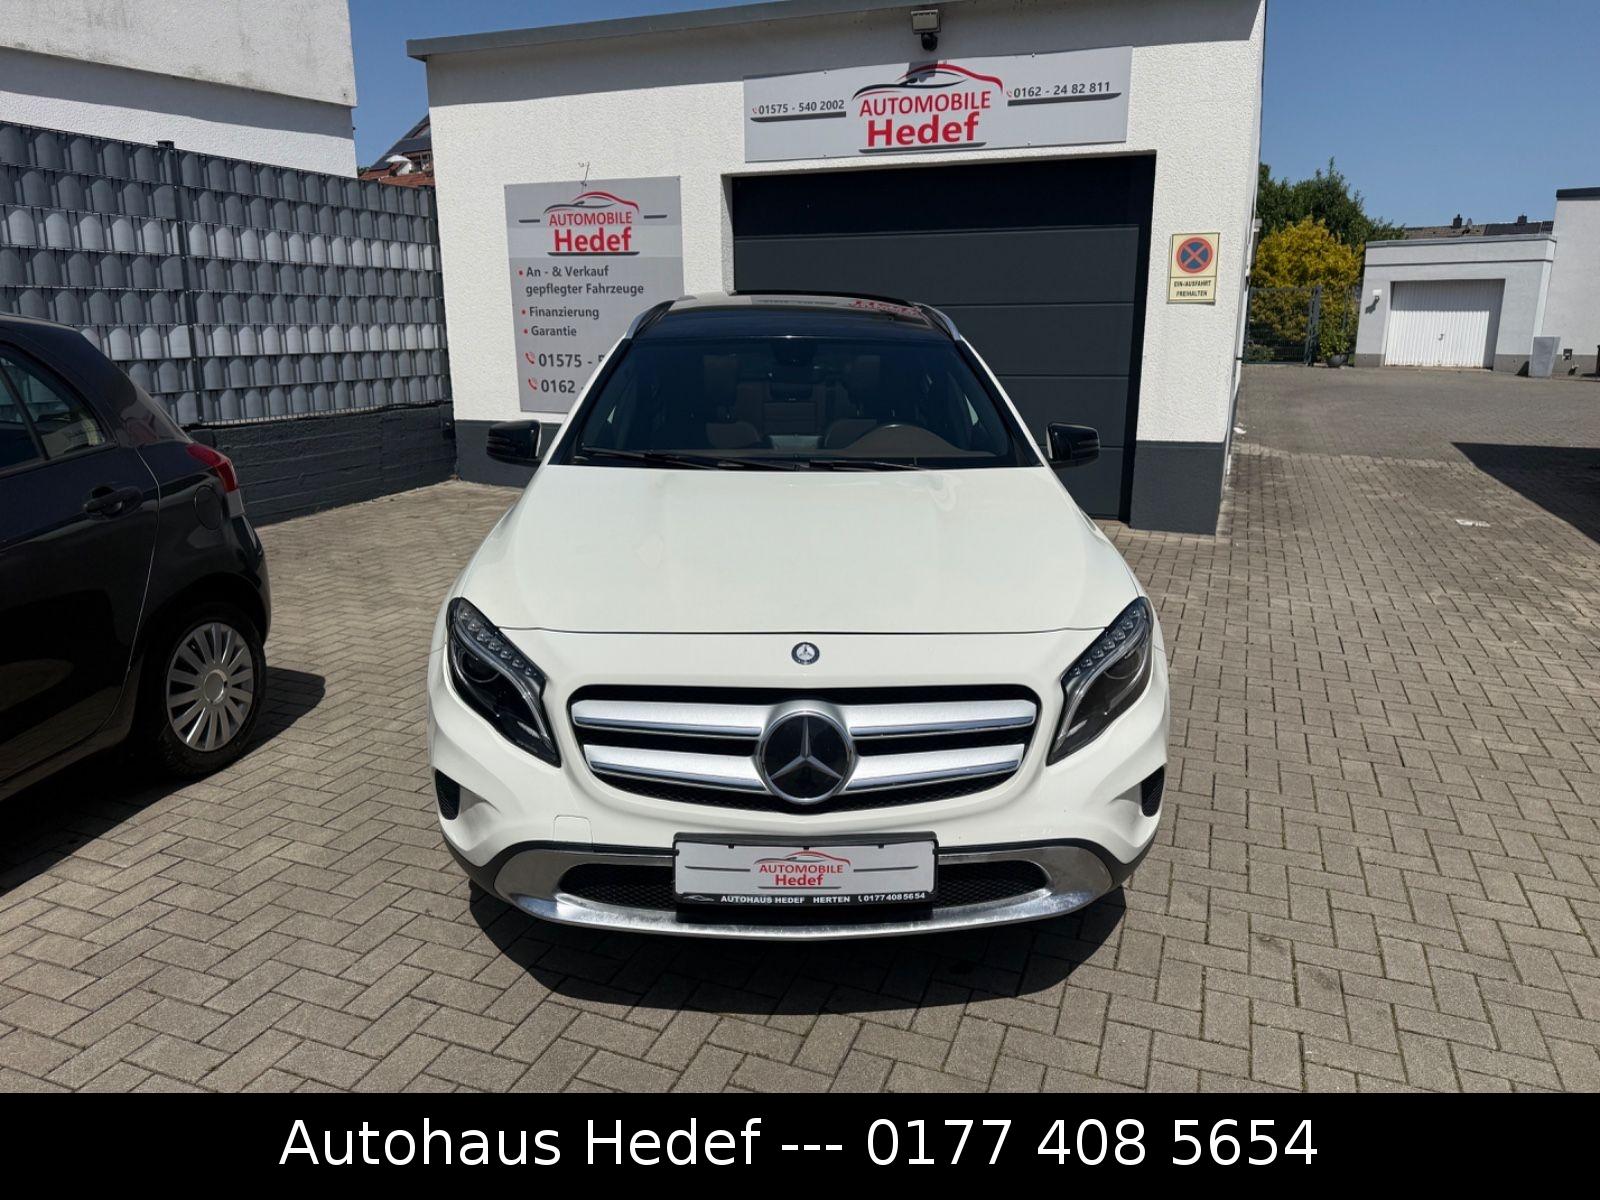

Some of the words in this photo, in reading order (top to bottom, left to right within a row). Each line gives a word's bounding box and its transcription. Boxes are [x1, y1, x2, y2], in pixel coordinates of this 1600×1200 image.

[1014, 86, 1041, 98] 0162
[1053, 84, 1068, 96] 24
[1071, 83, 1085, 94] 82
[1089, 81, 1110, 93] 811
[758, 103, 788, 115] 01575
[799, 101, 817, 112] 540
[820, 99, 845, 111] 2002
[859, 90, 991, 117] AUTOMOBILE
[867, 111, 980, 147] Hedef
[549, 211, 632, 227] AUTOMOBILE
[554, 227, 632, 252] Hedef
[526, 266, 541, 278] An
[552, 266, 563, 278] &
[565, 265, 609, 277] Verkauf
[525, 283, 583, 297] gepflegter
[586, 283, 644, 296] Fahrzeuge
[529, 306, 600, 320] Finanzierung
[531, 325, 577, 337] Garantie
[538, 353, 582, 368] 01575
[541, 379, 576, 393] 0162
[759, 864, 844, 874] AUTOMOBILE
[775, 874, 824, 887] Hedef
[720, 895, 773, 904] AUTOHAUS
[774, 896, 805, 904] HEDEF
[812, 896, 850, 904] HERTEN
